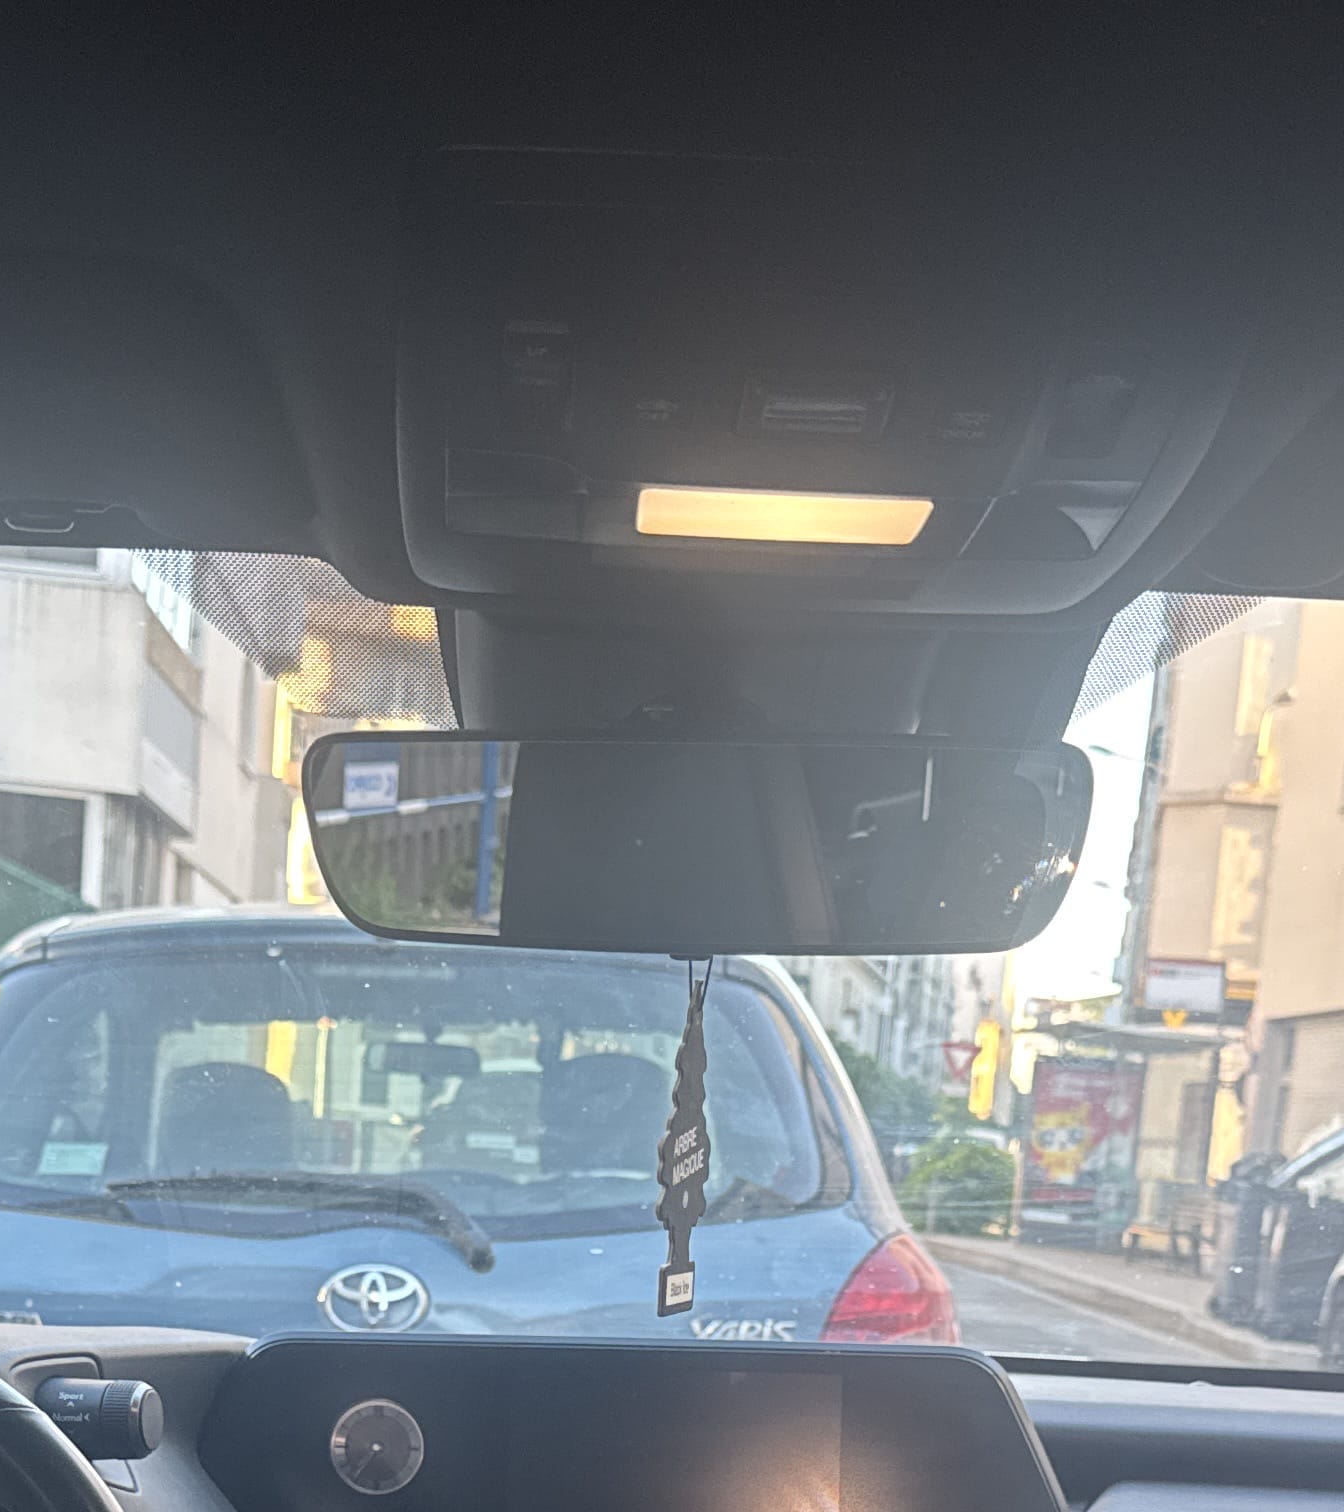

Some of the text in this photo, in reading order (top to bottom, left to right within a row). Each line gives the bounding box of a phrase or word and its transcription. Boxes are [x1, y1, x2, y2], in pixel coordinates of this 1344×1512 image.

[673, 1126, 698, 1158] ARBRE
[671, 1147, 705, 1186] MAGIQUE
[689, 1317, 798, 1341] YARIS
[57, 1391, 85, 1401] Sport
[52, 1411, 83, 1423] Normal
